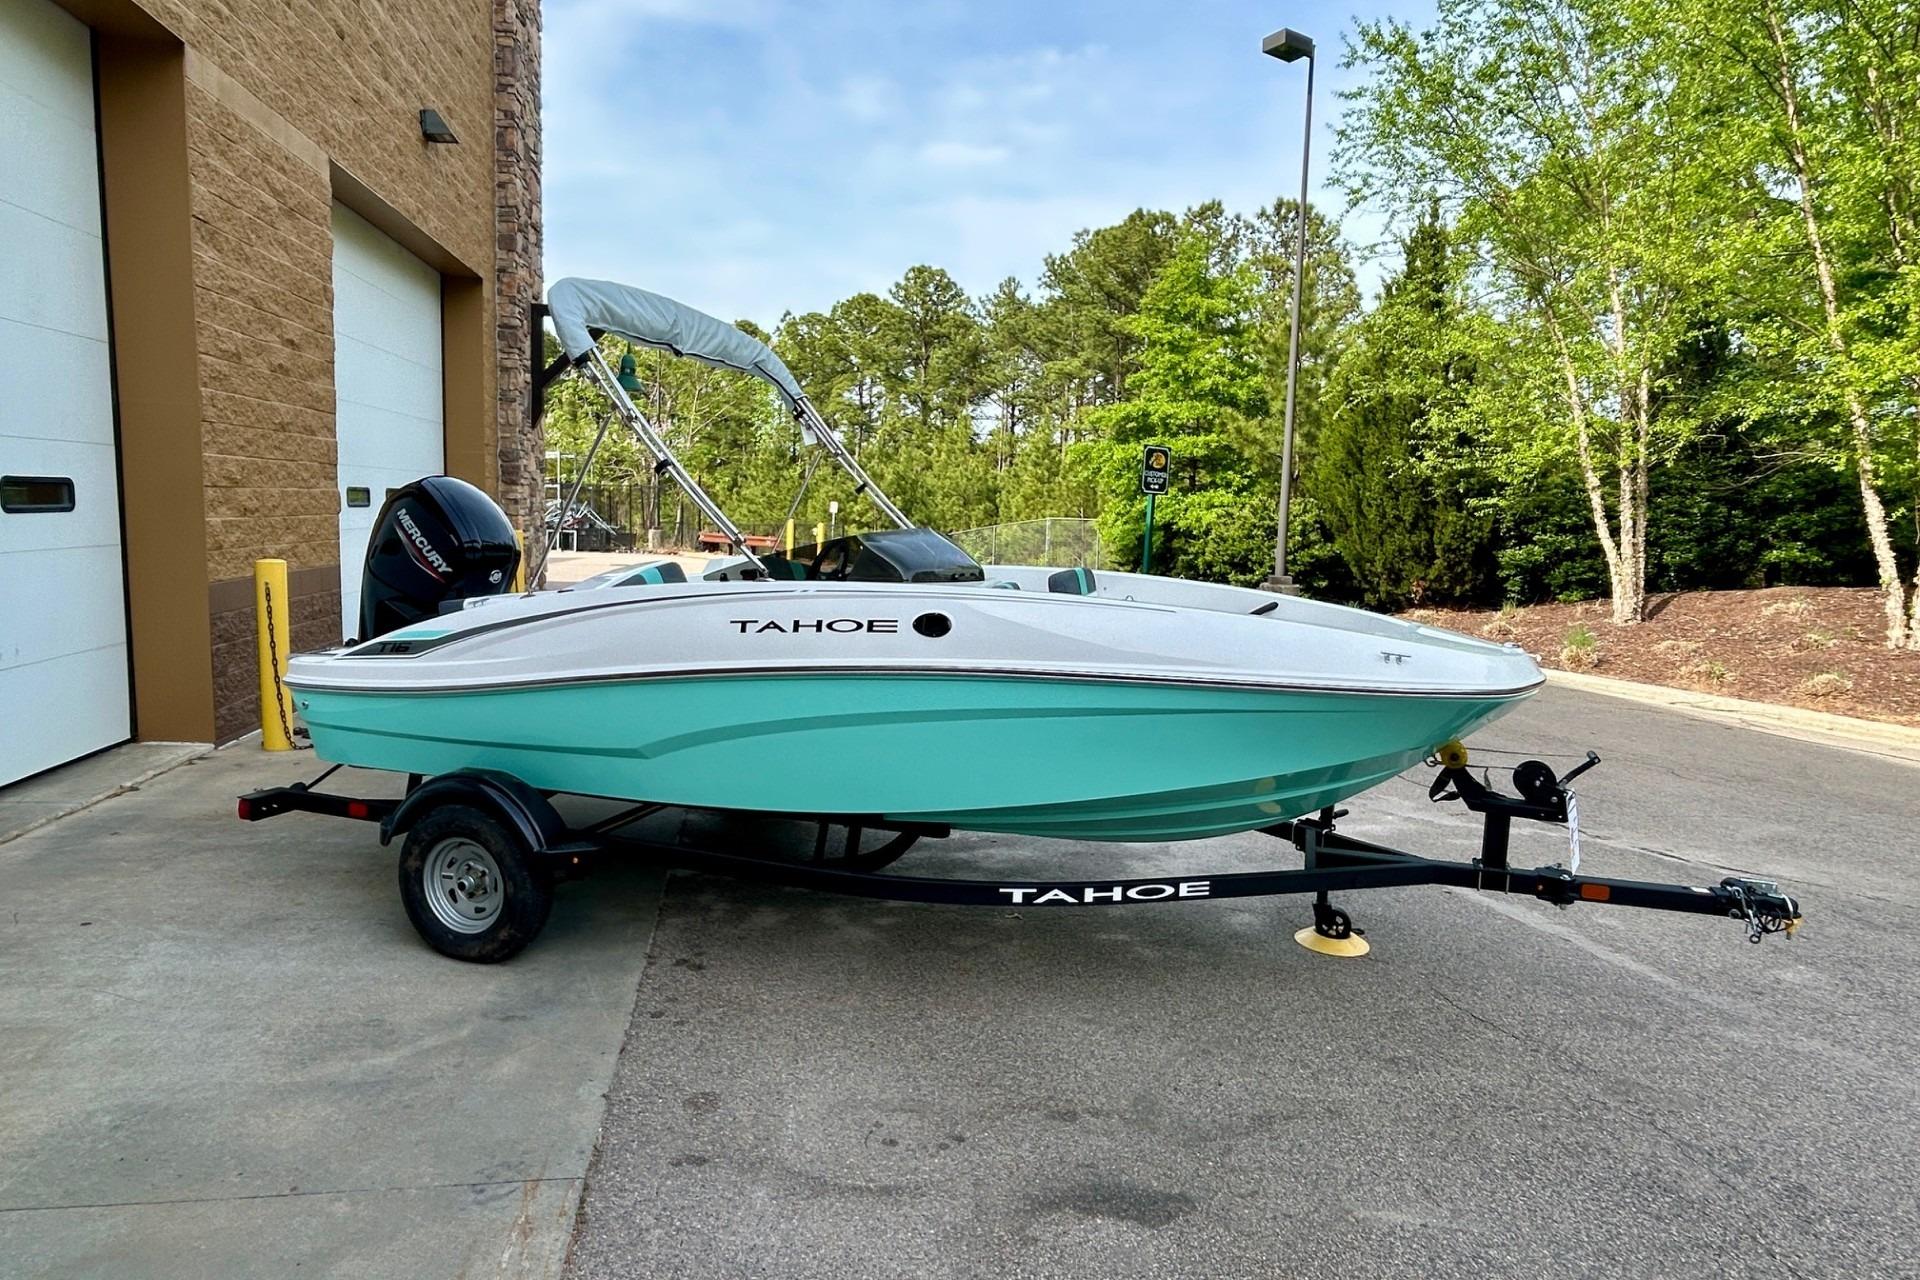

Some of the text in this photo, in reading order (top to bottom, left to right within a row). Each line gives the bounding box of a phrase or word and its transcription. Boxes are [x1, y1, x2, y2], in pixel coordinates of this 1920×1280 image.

[397, 508, 453, 572] MERCURY
[729, 619, 899, 634] TAHOE
[378, 641, 412, 653] T16
[999, 881, 1210, 904] TAHOE
